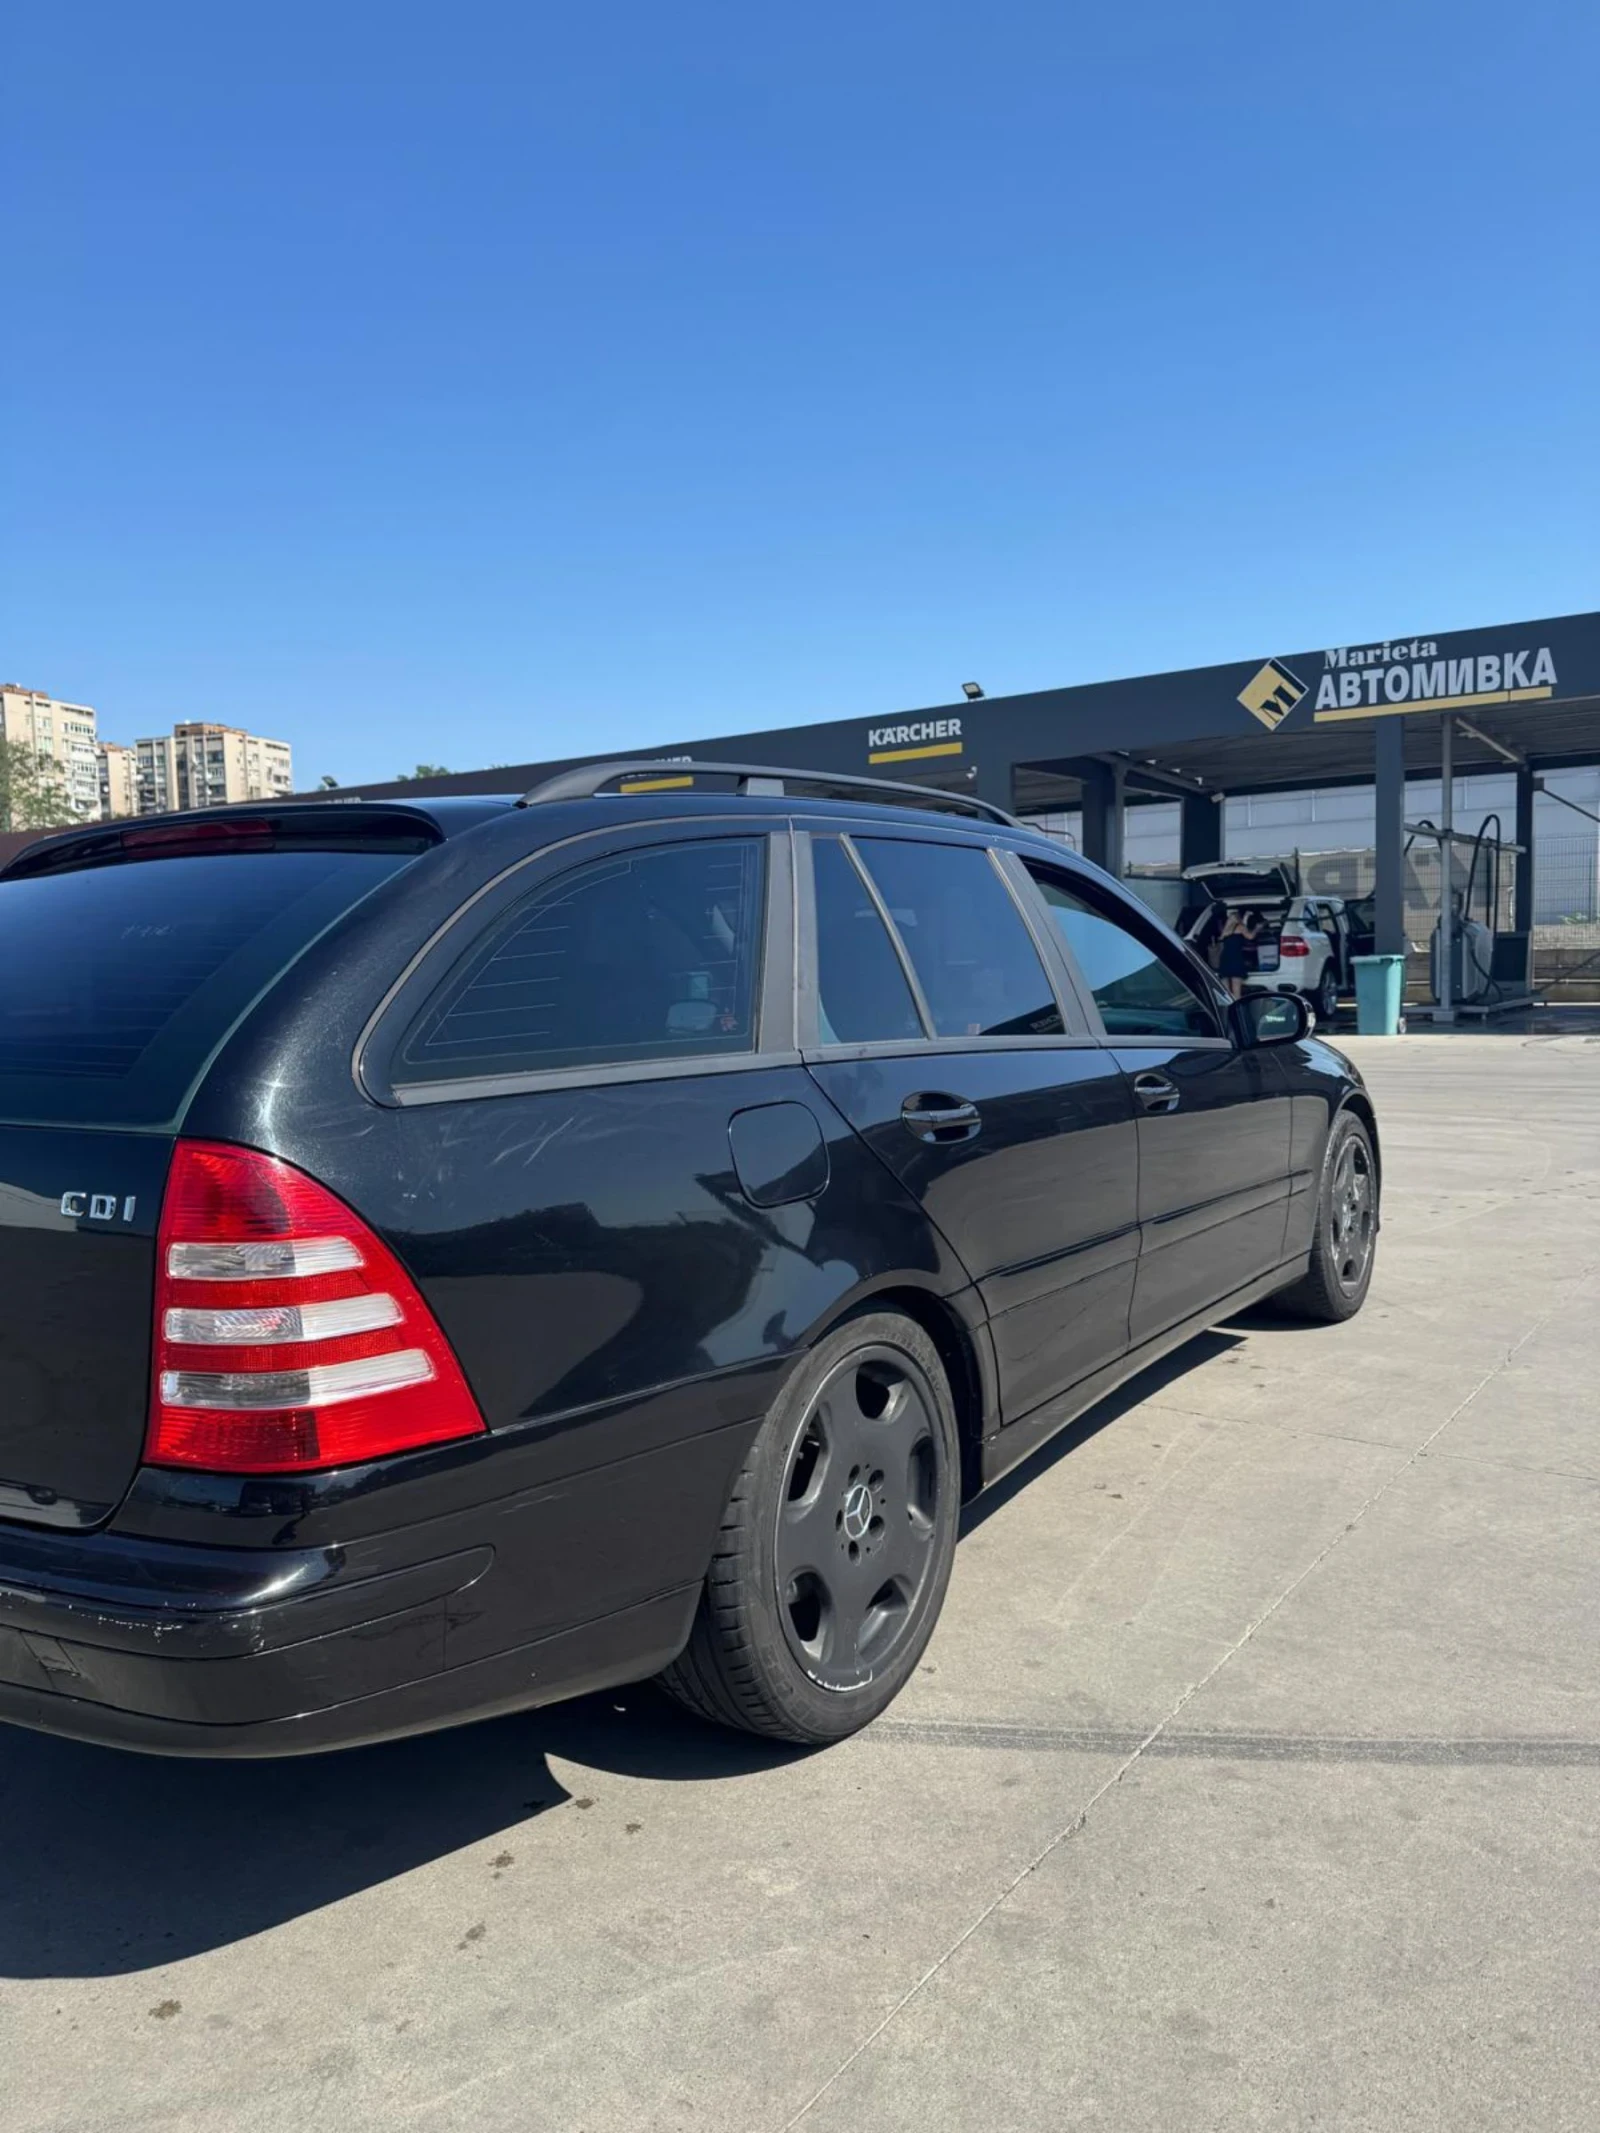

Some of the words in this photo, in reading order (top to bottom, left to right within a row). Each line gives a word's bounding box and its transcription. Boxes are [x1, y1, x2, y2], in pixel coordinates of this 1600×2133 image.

[1323, 639, 1438, 670] Marieta
[1315, 646, 1557, 711] АВТОМИВКА
[868, 718, 962, 748] KÄRCHER
[60, 1191, 137, 1222] CDI
